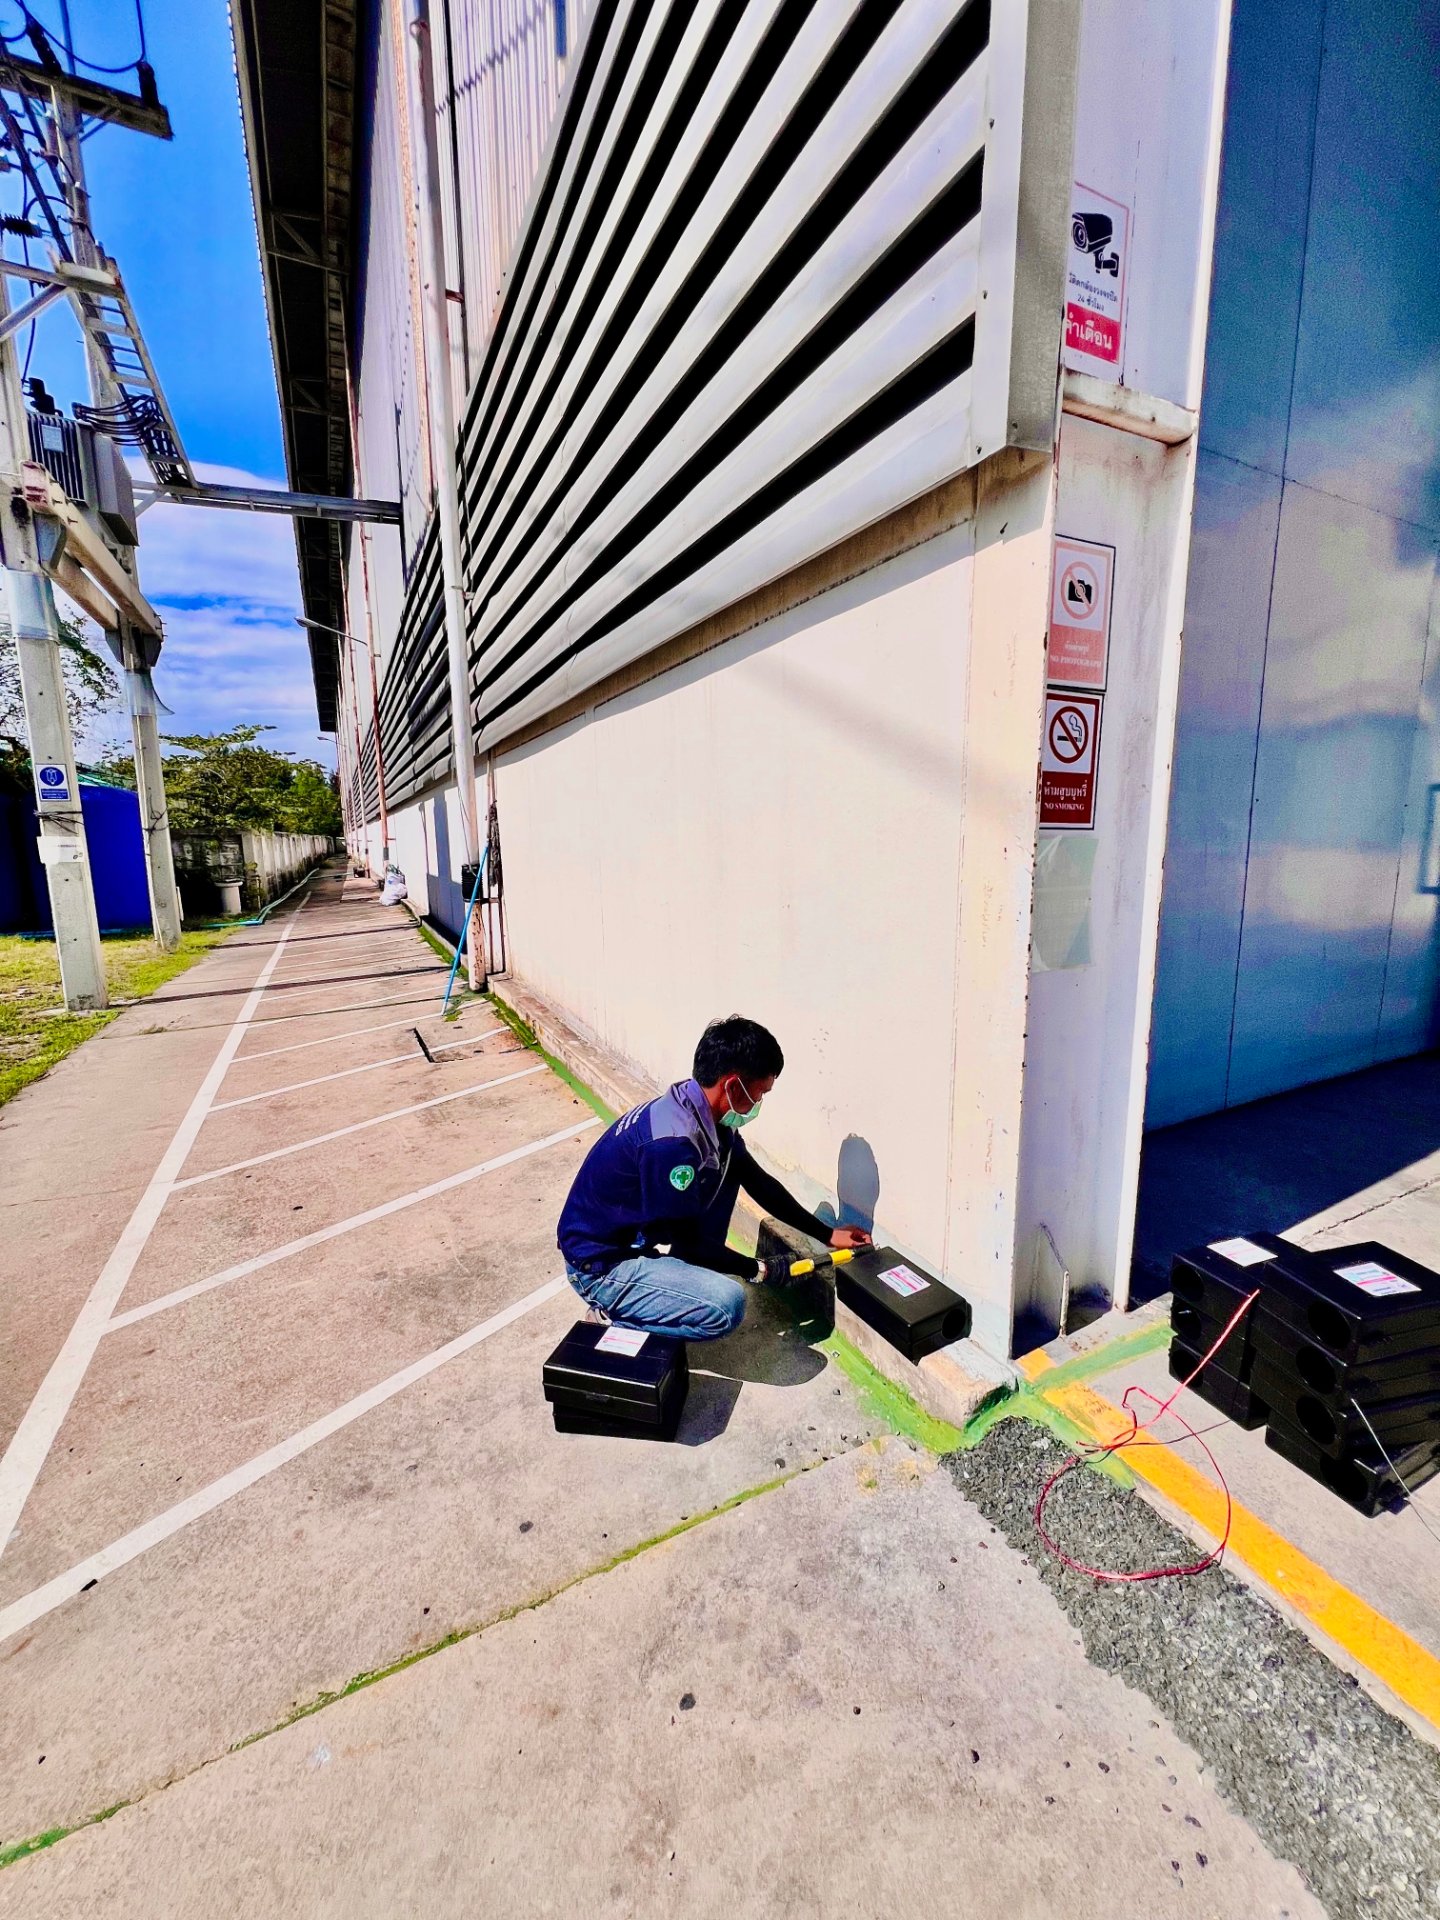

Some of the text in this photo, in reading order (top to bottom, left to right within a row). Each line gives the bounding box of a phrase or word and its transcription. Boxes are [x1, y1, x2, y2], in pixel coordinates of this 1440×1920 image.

[1077, 293, 1105, 311] 24 ชั่วโมง
[1044, 779, 1088, 801] ห้ามสูบบุหรี่
[1044, 802, 1085, 811] NO SMOKING
